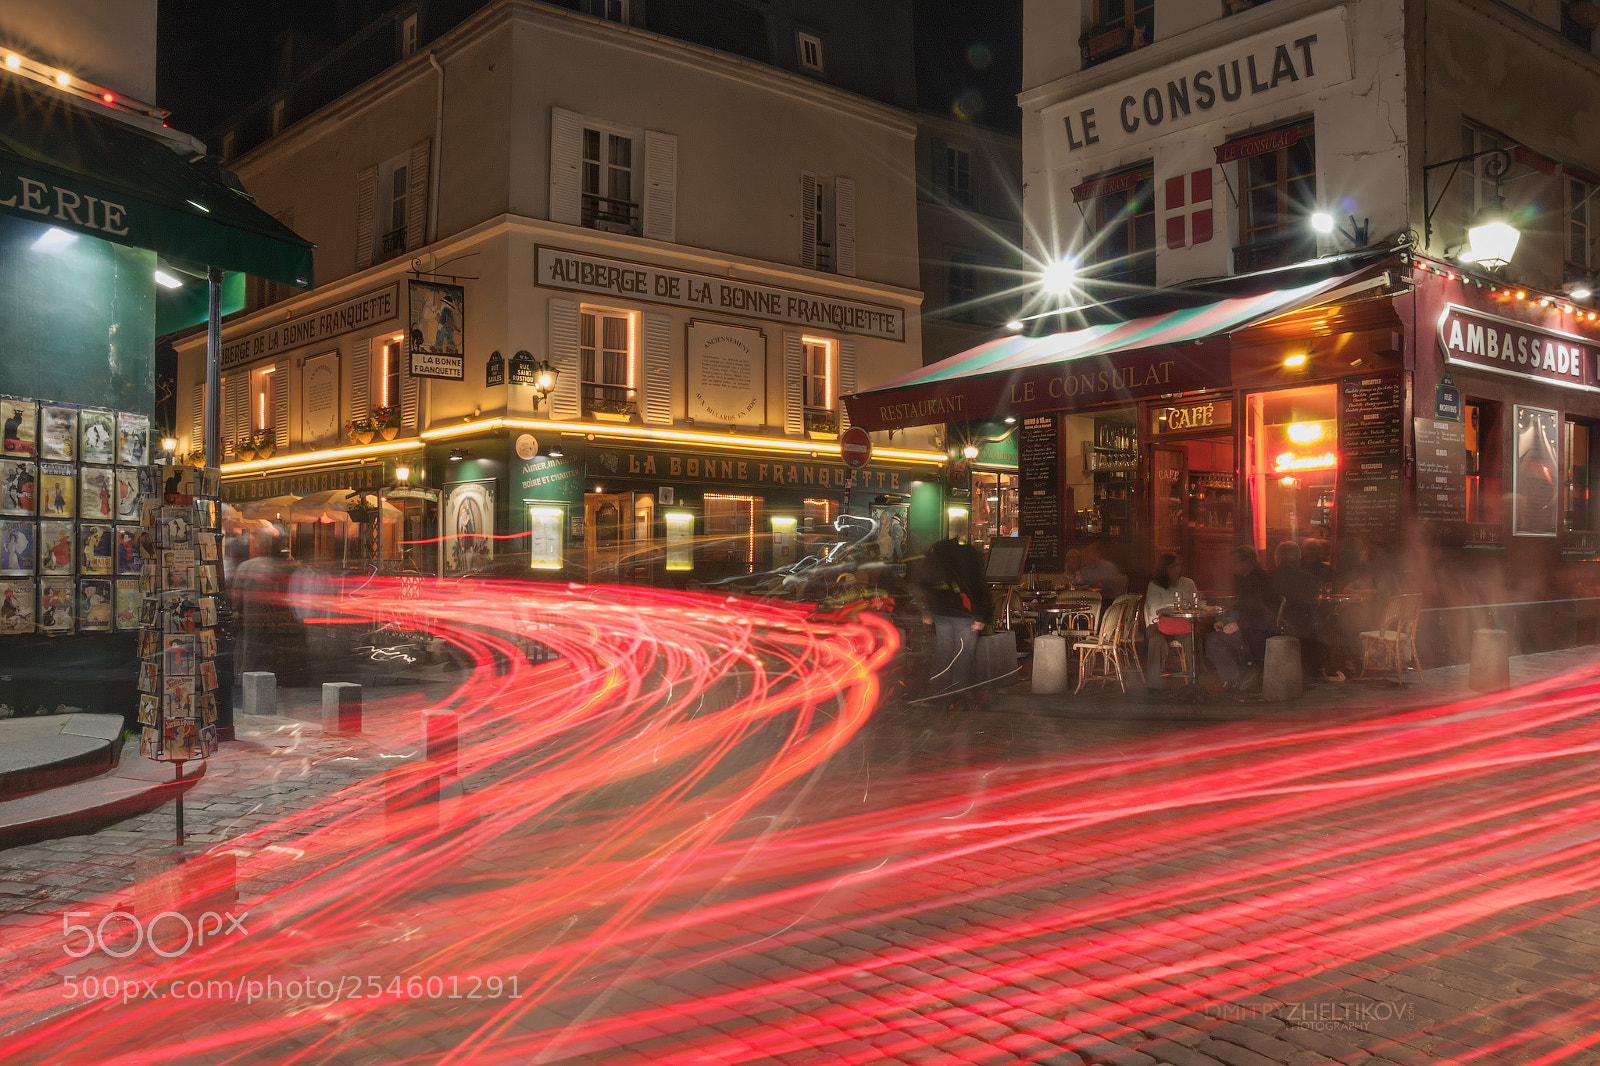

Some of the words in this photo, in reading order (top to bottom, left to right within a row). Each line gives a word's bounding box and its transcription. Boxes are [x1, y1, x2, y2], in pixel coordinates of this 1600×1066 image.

[1064, 108, 1100, 152] LE
[1120, 33, 1318, 134] CONSULAT
[1223, 148, 1236, 161] LE
[1239, 131, 1291, 157] CONSULAT
[1079, 175, 1131, 199] RESTAURANT
[549, 257, 648, 294] AUBERGE
[654, 274, 681, 299] DE
[687, 279, 713, 304] LA
[720, 285, 782, 316] BONNE
[787, 296, 896, 335] FRANQUETTE
[253, 336, 265, 356] DE
[268, 331, 279, 350] LA
[283, 318, 316, 347] BONNE
[320, 292, 391, 335] FRANQUETTE
[422, 356, 434, 364] LA
[435, 357, 462, 367] BONNE
[1449, 319, 1580, 377] AMBASSADE
[414, 364, 461, 376] FRANQUETTE
[1010, 382, 1036, 404] LE
[1049, 360, 1175, 399] CONSULAT
[879, 394, 964, 422] RESTAURANT
[1443, 393, 1453, 402] RUE
[1168, 402, 1215, 430] CAFÉ
[541, 475, 550, 485] ET
[628, 453, 657, 475] LA
[669, 456, 748, 480] BONNE
[759, 463, 900, 489] FRANQUETTE
